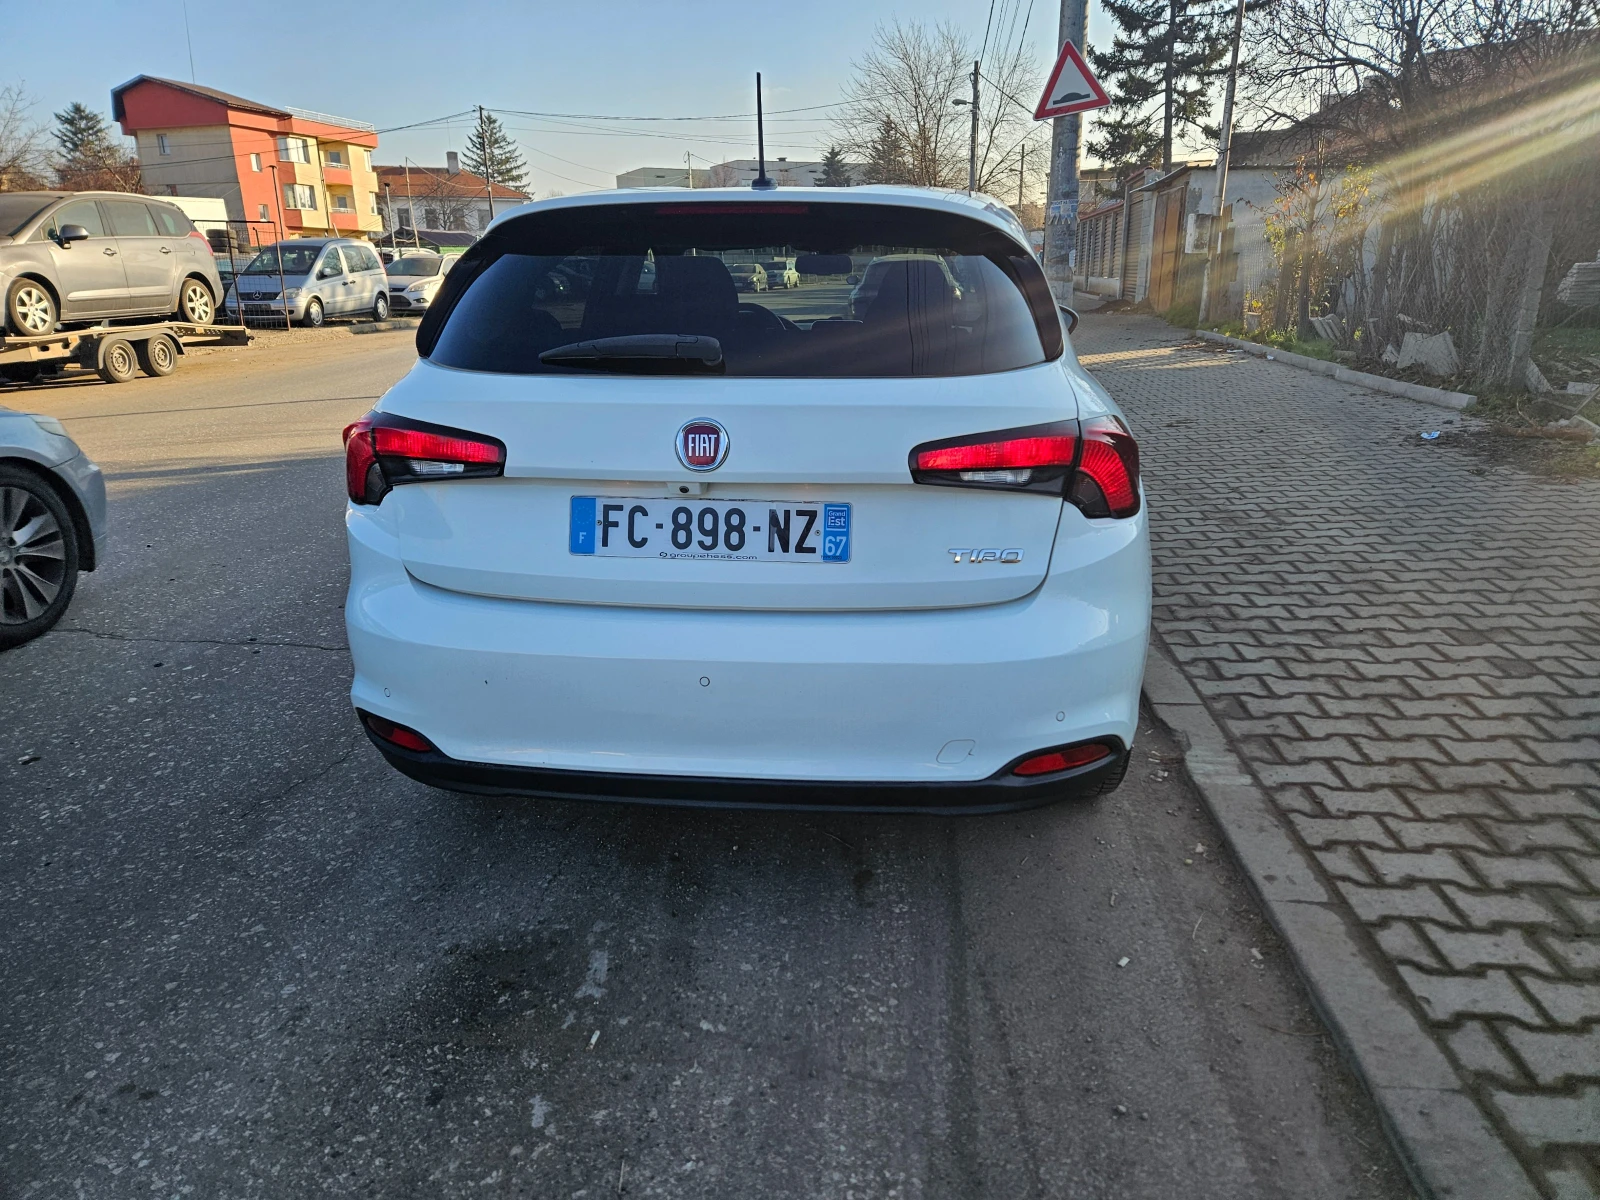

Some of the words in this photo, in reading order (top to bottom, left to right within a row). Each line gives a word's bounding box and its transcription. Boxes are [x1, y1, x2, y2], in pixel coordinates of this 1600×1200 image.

[688, 434, 717, 457] FIAT
[828, 516, 846, 526] Est
[602, 504, 818, 554] FC-898-NZ
[579, 532, 587, 544] F
[825, 535, 847, 556] 67
[669, 552, 758, 560] groupehess.com
[948, 548, 1024, 563] TIPO
